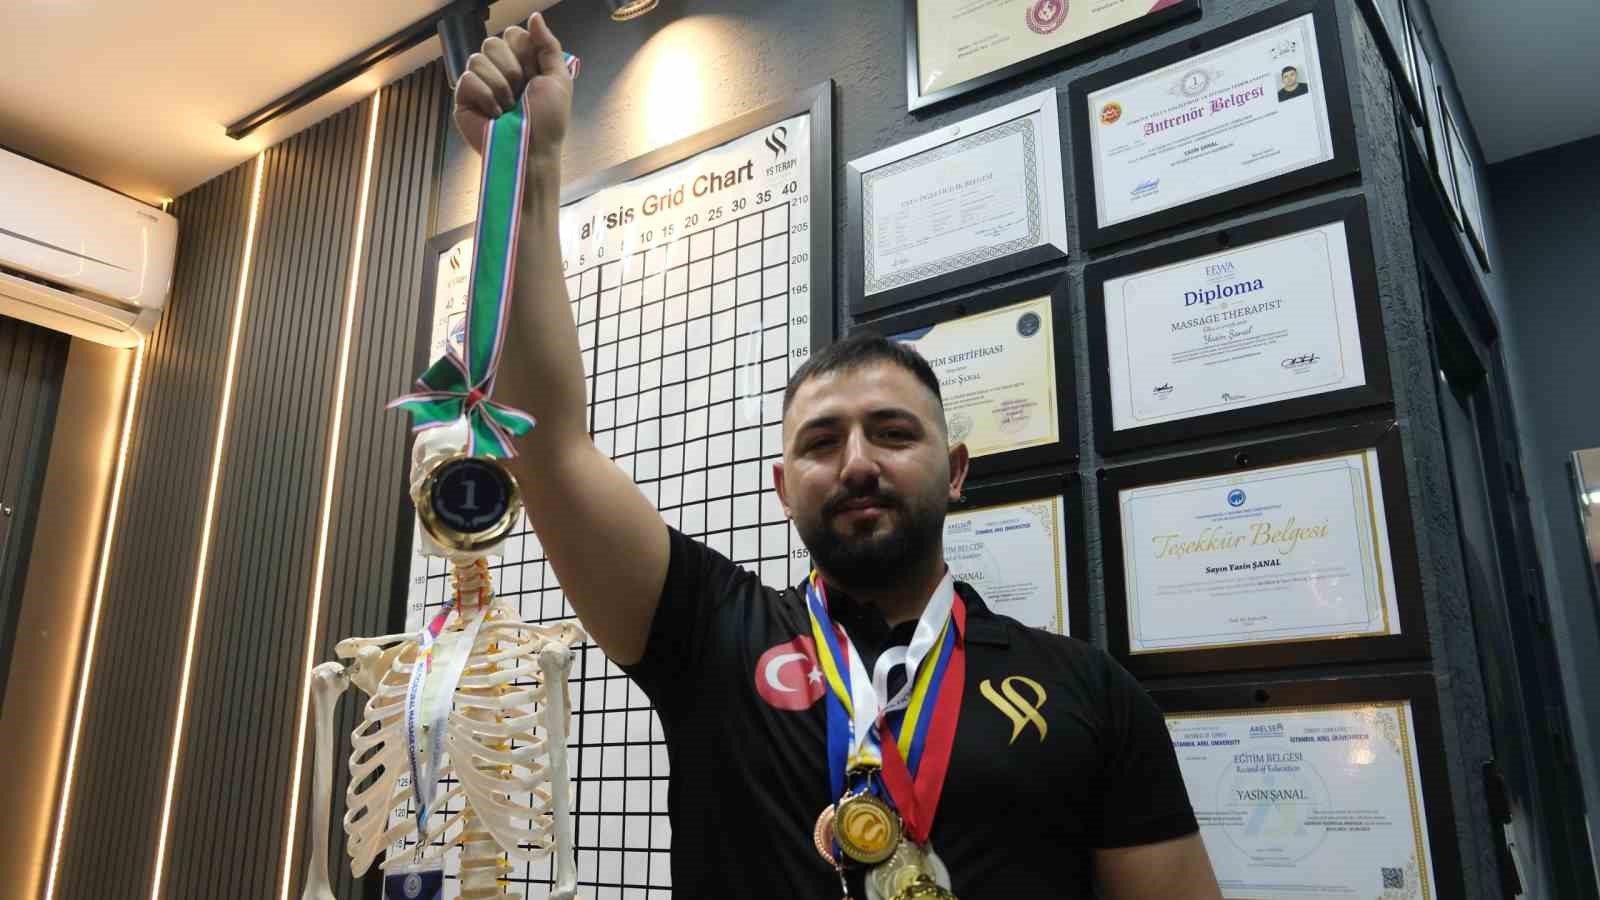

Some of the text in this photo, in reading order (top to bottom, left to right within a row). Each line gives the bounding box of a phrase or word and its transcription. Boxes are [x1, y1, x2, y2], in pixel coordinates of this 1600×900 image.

[1144, 106, 1205, 136] Antrenör
[642, 184, 684, 217] Grid
[692, 159, 754, 198] Chart
[640, 230, 653, 244] 10
[684, 213, 699, 229] 20
[708, 206, 723, 222] 25
[731, 197, 746, 212] 30
[756, 190, 772, 205] 35
[781, 180, 798, 195] 40
[791, 222, 809, 235] 205
[791, 253, 809, 265] 200
[791, 284, 809, 296] 195
[1184, 278, 1264, 307] Diploma
[791, 314, 809, 327] 190
[1171, 299, 1282, 333] MASSAGE THERAPIST
[791, 346, 809, 358] 185
[458, 480, 479, 510] 1
[1249, 515, 1329, 555] Belgesi
[791, 549, 809, 560] 155
[1251, 558, 1281, 571] ŞANAL
